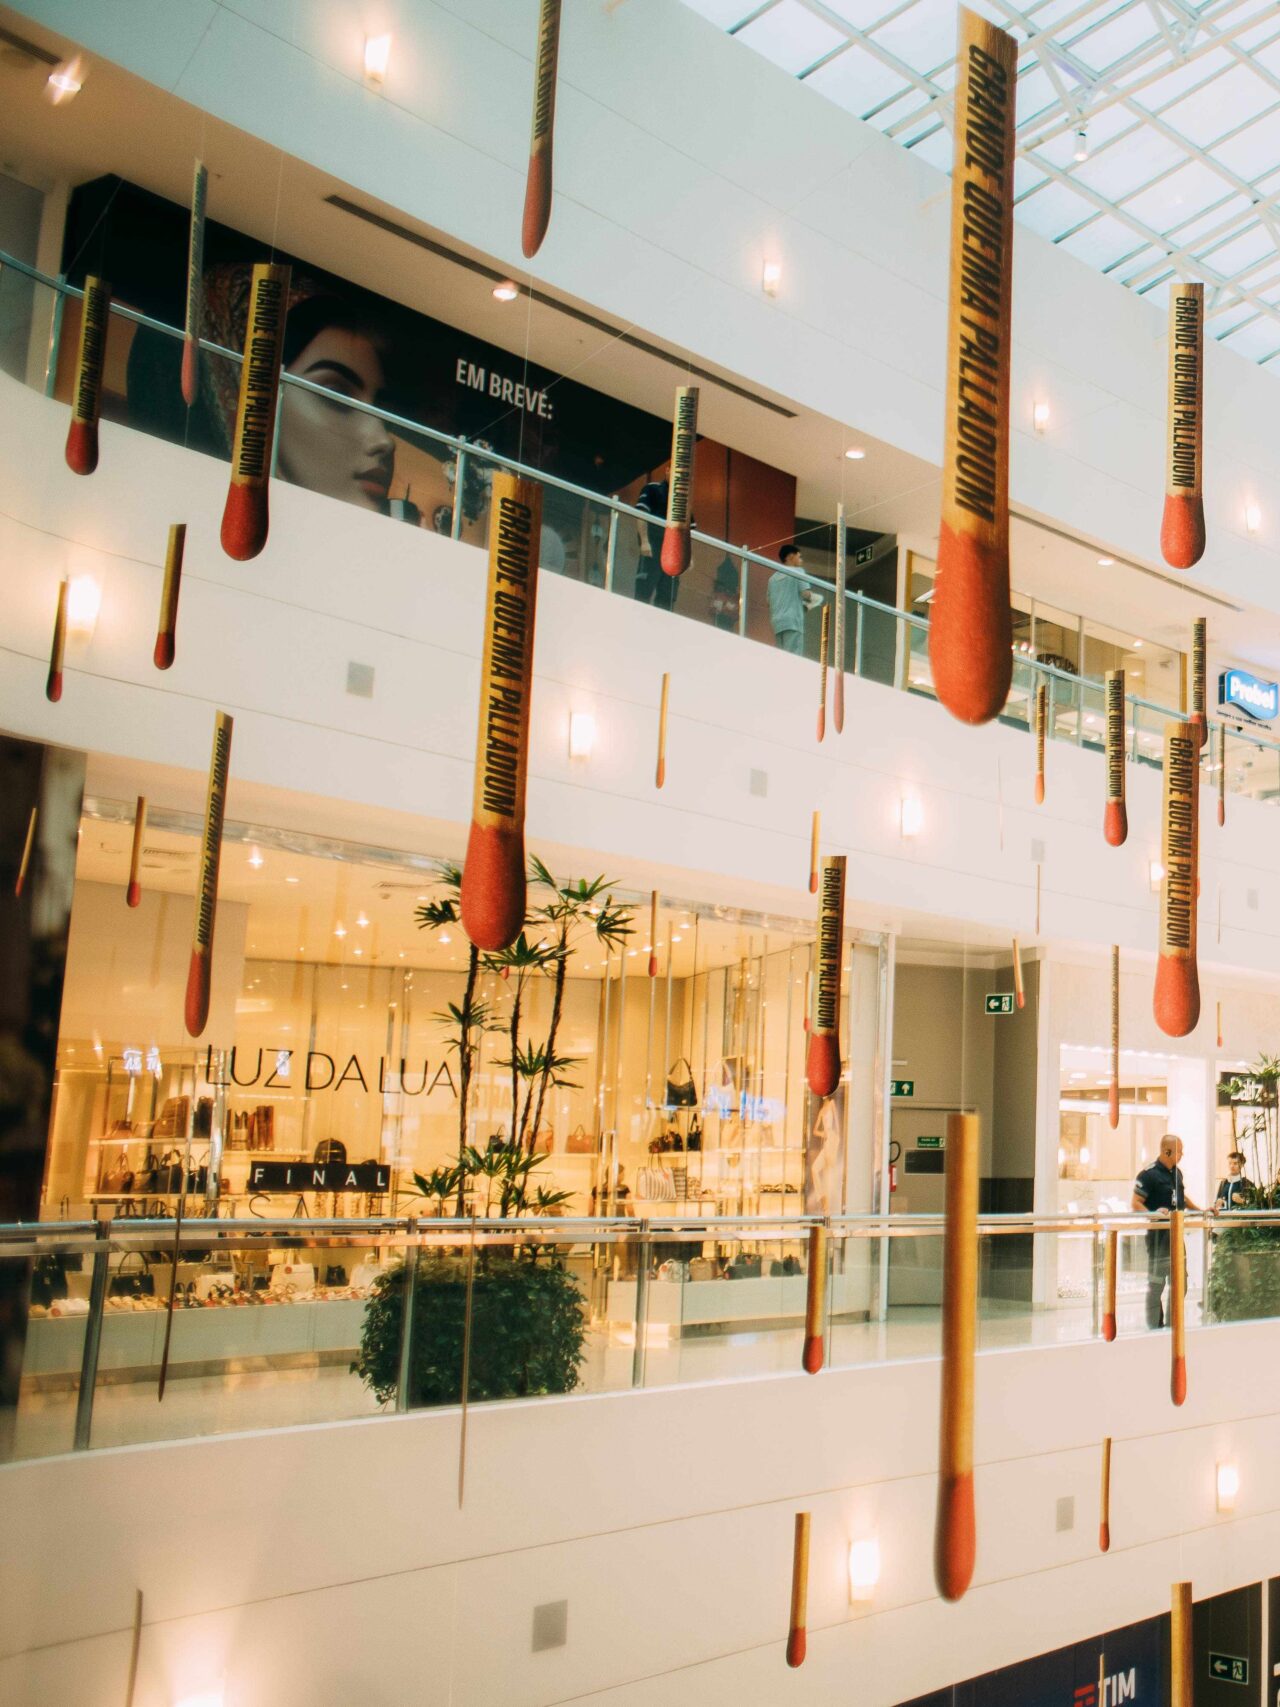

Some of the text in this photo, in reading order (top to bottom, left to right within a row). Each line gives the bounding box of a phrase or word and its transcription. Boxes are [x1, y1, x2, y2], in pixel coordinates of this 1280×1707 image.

[954, 45, 1008, 521] GRANDE QUEIMA PALLADIUM
[239, 279, 281, 476] GRANDE QUEIMA PALLADIUM
[455, 358, 553, 420] EM BREVE:
[1172, 297, 1199, 488] GRANDE QUEIMA PALLADIUM
[671, 396, 694, 523] GRANDE QUEIMA PALLADIUM
[483, 497, 530, 816] GRANDE QUEIMA PALLADIUM
[1109, 680, 1122, 798] GRANDE QUEIMA PALLADIUM
[197, 727, 226, 945] GRANDE QUEIMA PALLADIUM
[1167, 737, 1193, 948] GRANDE QUEIMA PALLADIUM
[817, 868, 841, 1028] GRANDE QUEIMA PALLADIUM
[205, 1044, 293, 1089] LUZ
[304, 1051, 369, 1093] DA
[378, 1056, 458, 1099] LUA
[253, 1168, 386, 1188] FINAL
[1098, 1667, 1136, 1707] TIM
